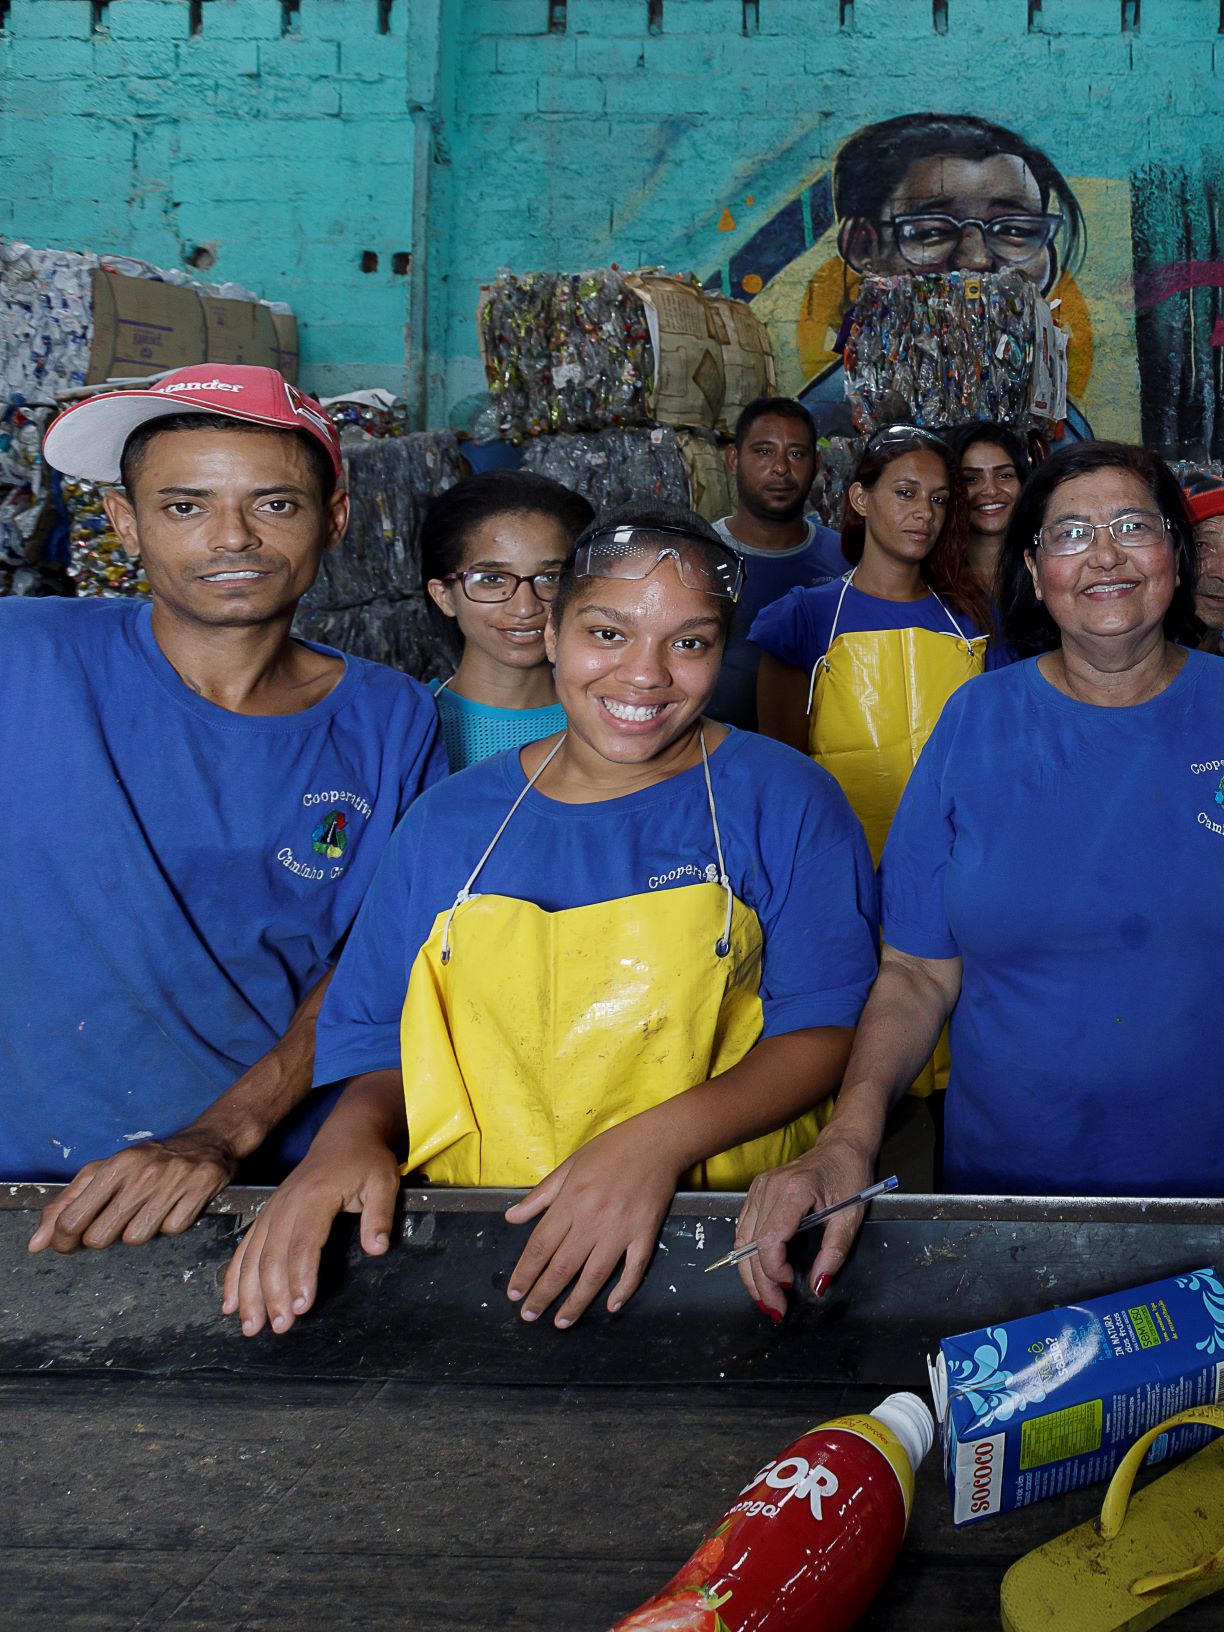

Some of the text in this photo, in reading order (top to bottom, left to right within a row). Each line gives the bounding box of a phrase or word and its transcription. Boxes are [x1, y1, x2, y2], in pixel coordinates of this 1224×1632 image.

[277, 847, 324, 880] Caminho
[1103, 1314, 1121, 1345] NATURA
[1114, 1312, 1133, 1353] dos frutos
[970, 1442, 995, 1514] SOCOCO
